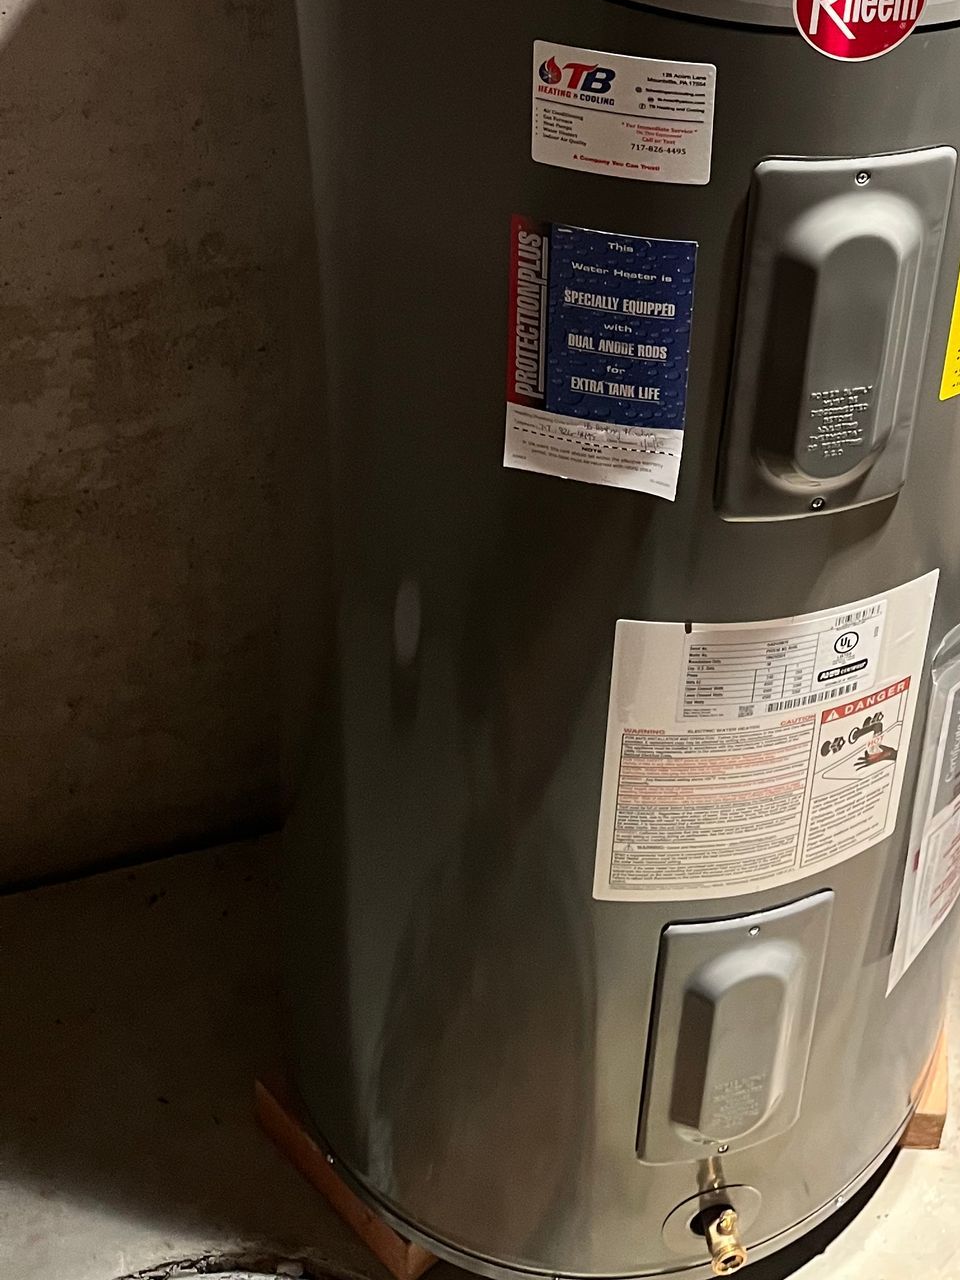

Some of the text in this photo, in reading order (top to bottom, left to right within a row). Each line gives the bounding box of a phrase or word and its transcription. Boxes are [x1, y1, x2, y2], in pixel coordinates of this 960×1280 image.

[561, 62, 616, 94] TB
[538, 84, 572, 99] HEATING
[579, 93, 615, 106] COOLING
[607, 241, 634, 253] This
[571, 261, 672, 283] Water Heater is
[564, 289, 676, 318] SPECIALLY EQUIPPED
[603, 322, 633, 334] with
[568, 333, 667, 360] DUAL ANODE RODS
[606, 365, 626, 375] for
[570, 376, 660, 401] EXTRA TANK LIFE
[840, 637, 853, 648] UL
[844, 682, 906, 715] DANGER
[780, 714, 816, 726] CAUTION
[623, 727, 666, 735] WARNING
[867, 735, 885, 747] HOT
